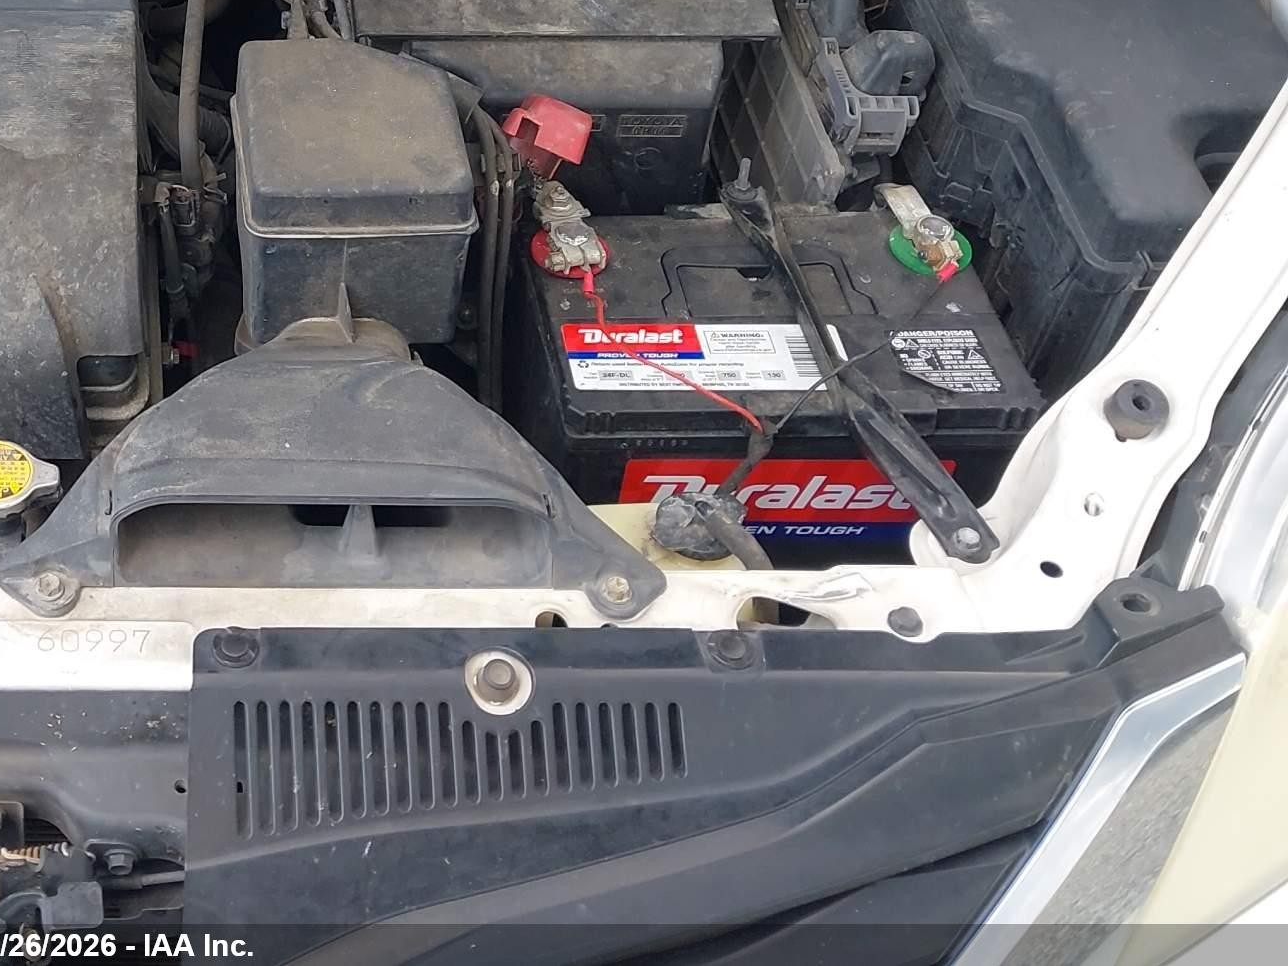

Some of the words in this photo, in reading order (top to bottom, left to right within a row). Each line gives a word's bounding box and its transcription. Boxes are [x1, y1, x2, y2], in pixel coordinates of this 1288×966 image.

[577, 328, 684, 344] Duralast
[643, 475, 911, 511] Dralas
[784, 525, 864, 535] TOUGH
[37, 628, 151, 653] 60997
